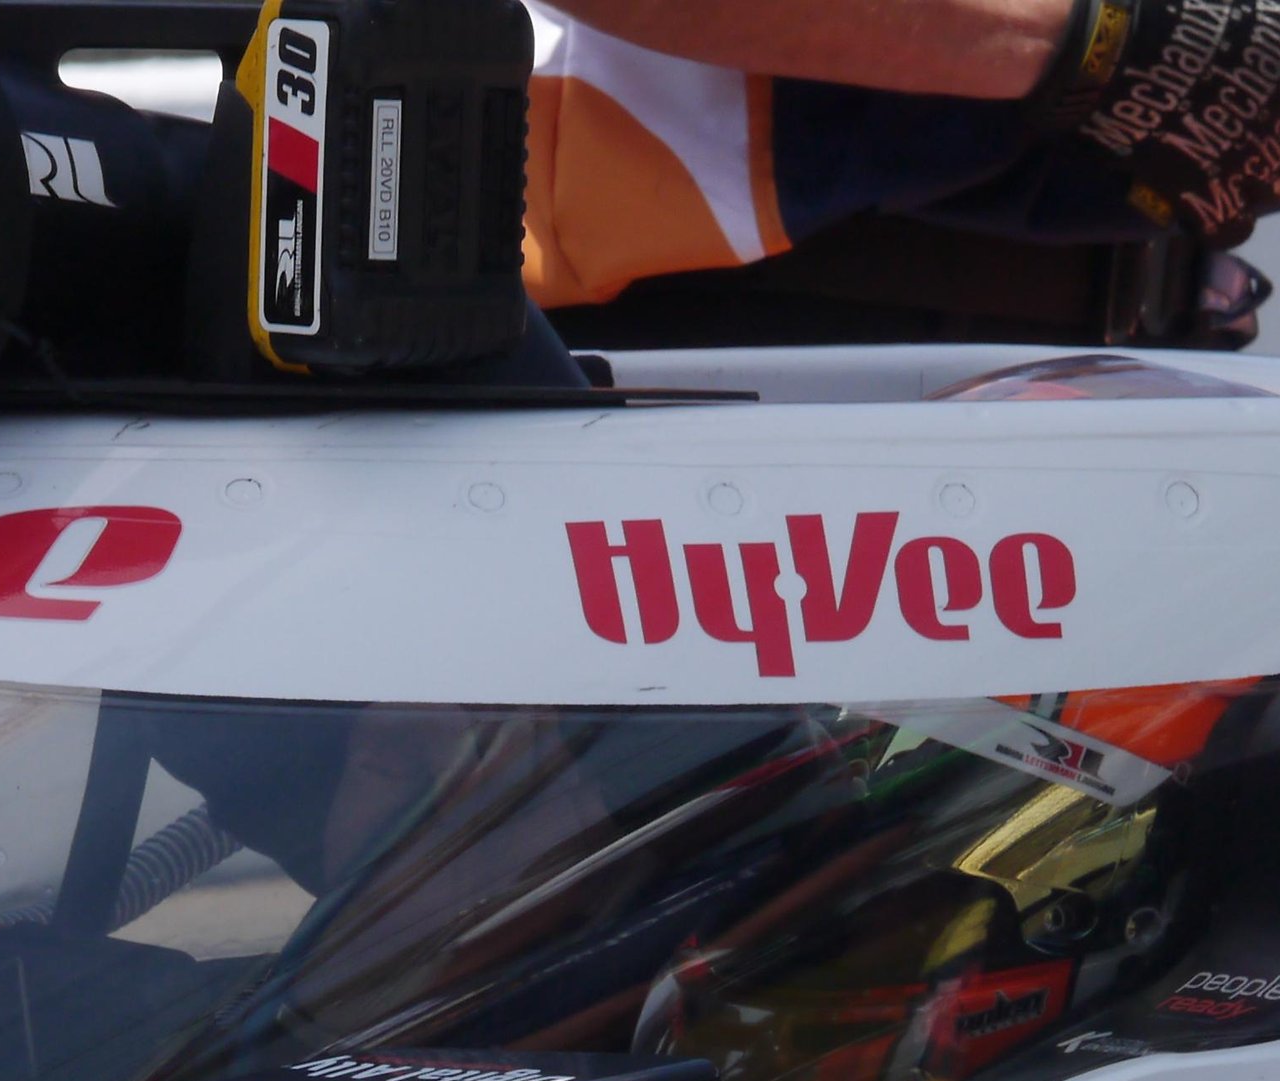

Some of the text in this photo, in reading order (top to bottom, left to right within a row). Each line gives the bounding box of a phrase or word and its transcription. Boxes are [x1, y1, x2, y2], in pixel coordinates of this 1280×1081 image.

[277, 26, 318, 117] 30
[381, 117, 395, 154] RLL
[378, 210, 392, 242] B10
[564, 510, 1077, 678] HyVee
[1157, 996, 1256, 1019] ready
[290, 1054, 412, 1080] Ally
